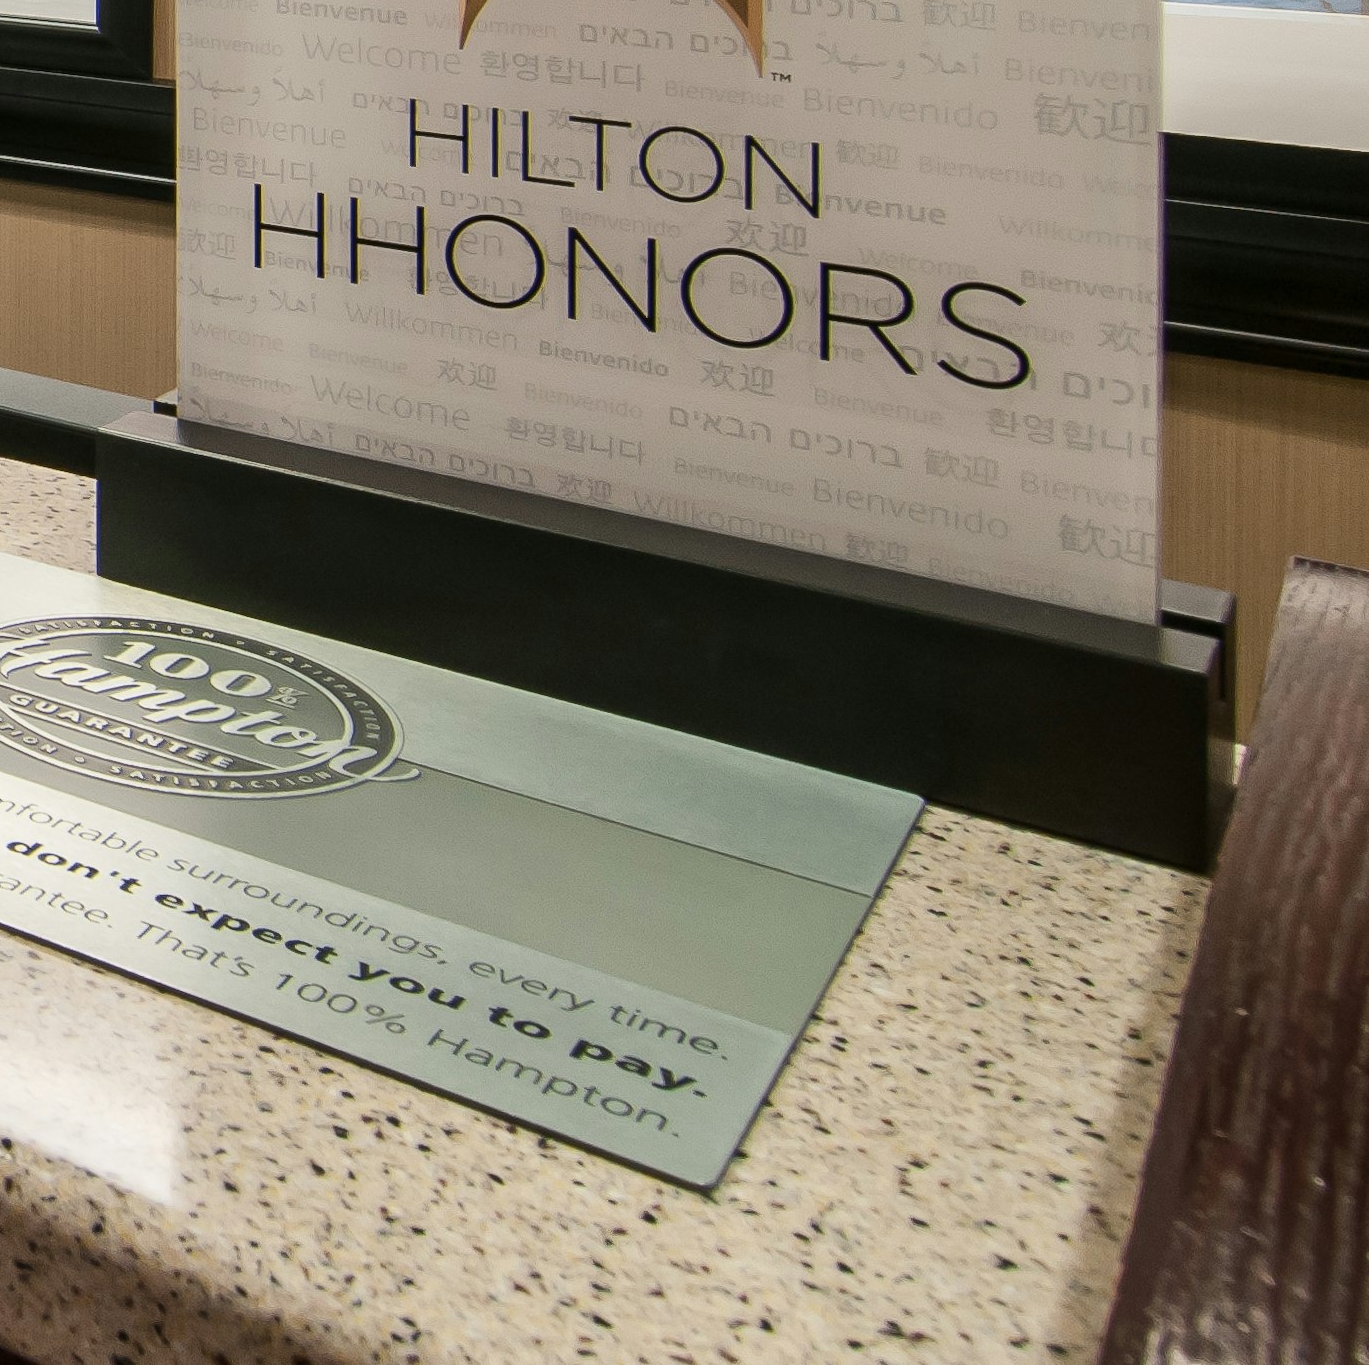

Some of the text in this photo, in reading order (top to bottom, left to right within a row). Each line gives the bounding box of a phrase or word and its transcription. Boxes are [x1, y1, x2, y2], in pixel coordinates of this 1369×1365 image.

[301, 31, 462, 76] Welcome
[192, 106, 347, 149] Bienvenue
[803, 86, 999, 132] Bienvenido
[408, 97, 821, 219] HILTON
[252, 182, 1032, 392] HHONORS
[343, 299, 670, 379] Willkommen Bienvenido
[311, 374, 471, 432] Welcome
[632, 488, 826, 553] Willkommen
[812, 477, 1011, 541] Bienvenido
[8, 693, 235, 771] GUARANTEE
[6, 840, 143, 895] don't
[154, 893, 339, 965] expect
[347, 961, 467, 1010] you
[487, 1005, 551, 1040] to
[568, 1037, 708, 1098] pay.
[166, 858, 448, 966] surroundings,
[468, 960, 596, 1013] every
[610, 1004, 729, 1062] time.
[136, 920, 257, 978] That's
[273, 971, 407, 1035] 100%
[426, 1028, 679, 1138] Hampton.
